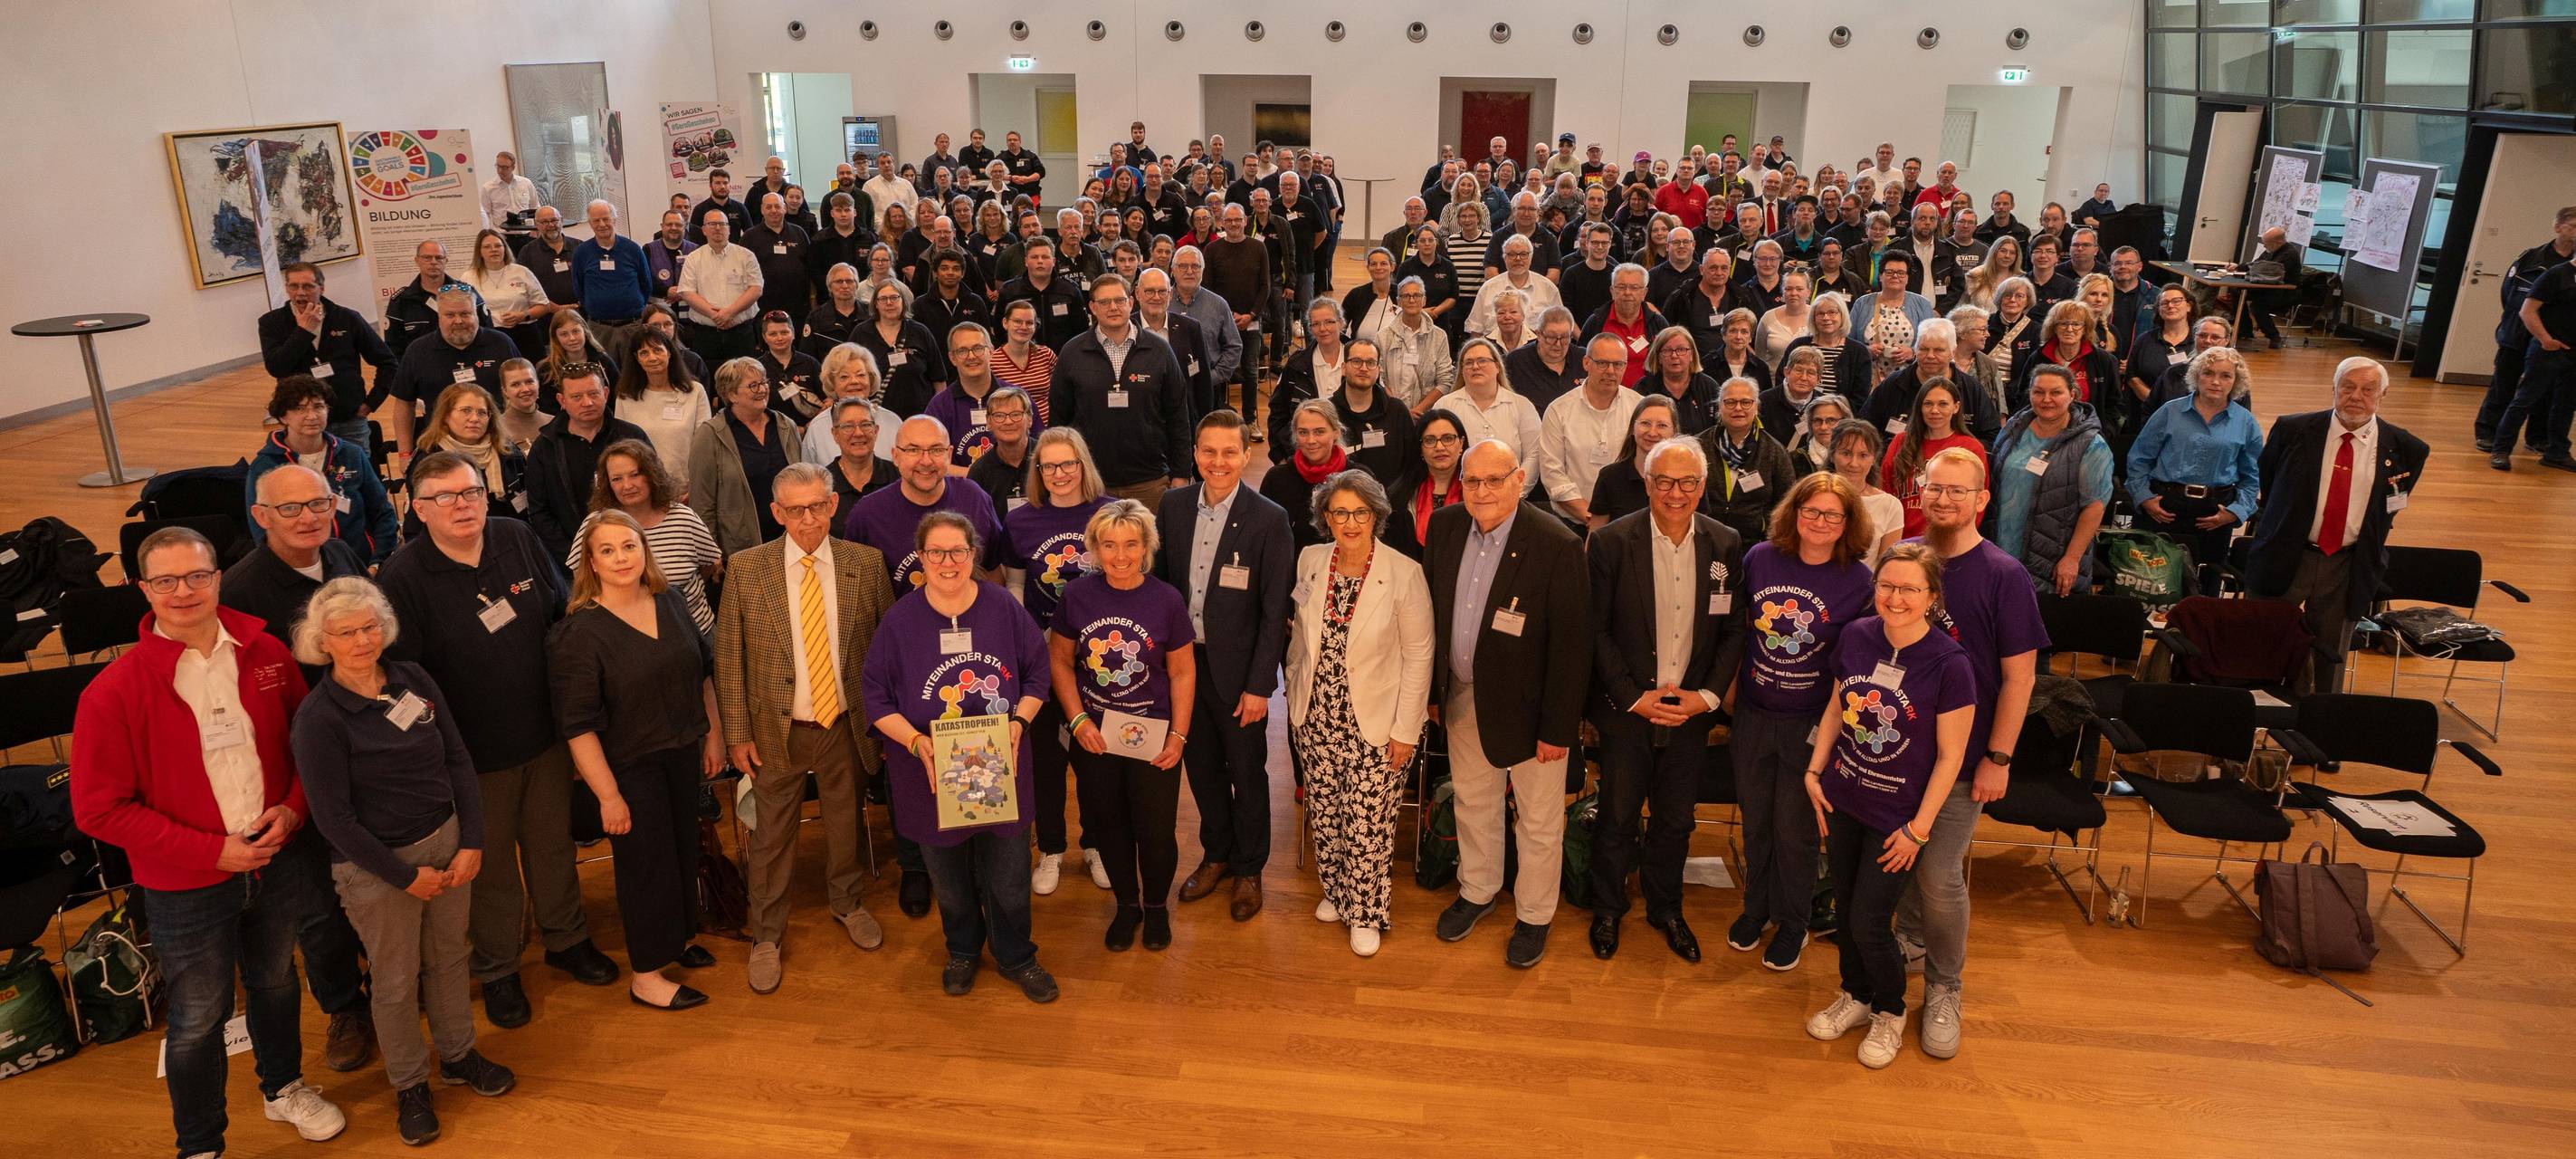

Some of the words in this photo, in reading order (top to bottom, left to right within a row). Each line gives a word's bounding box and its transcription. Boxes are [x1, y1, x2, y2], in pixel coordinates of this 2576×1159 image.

[681, 107, 703, 116] SAGEN
[377, 162, 405, 172] GOALS
[369, 209, 432, 222] BILDUNG
[1032, 532, 1084, 560] MITEINANDER
[893, 551, 919, 581] MITEIN
[1811, 597, 1830, 624] STARK
[1132, 624, 1156, 651] STARK
[921, 652, 982, 700] MITEINANDER
[983, 655, 1013, 682] STARK
[1894, 688, 1917, 721] STARK
[935, 717, 999, 732] KATASTROPHEN!
[1867, 770, 1906, 784] Ehrenamtstag
